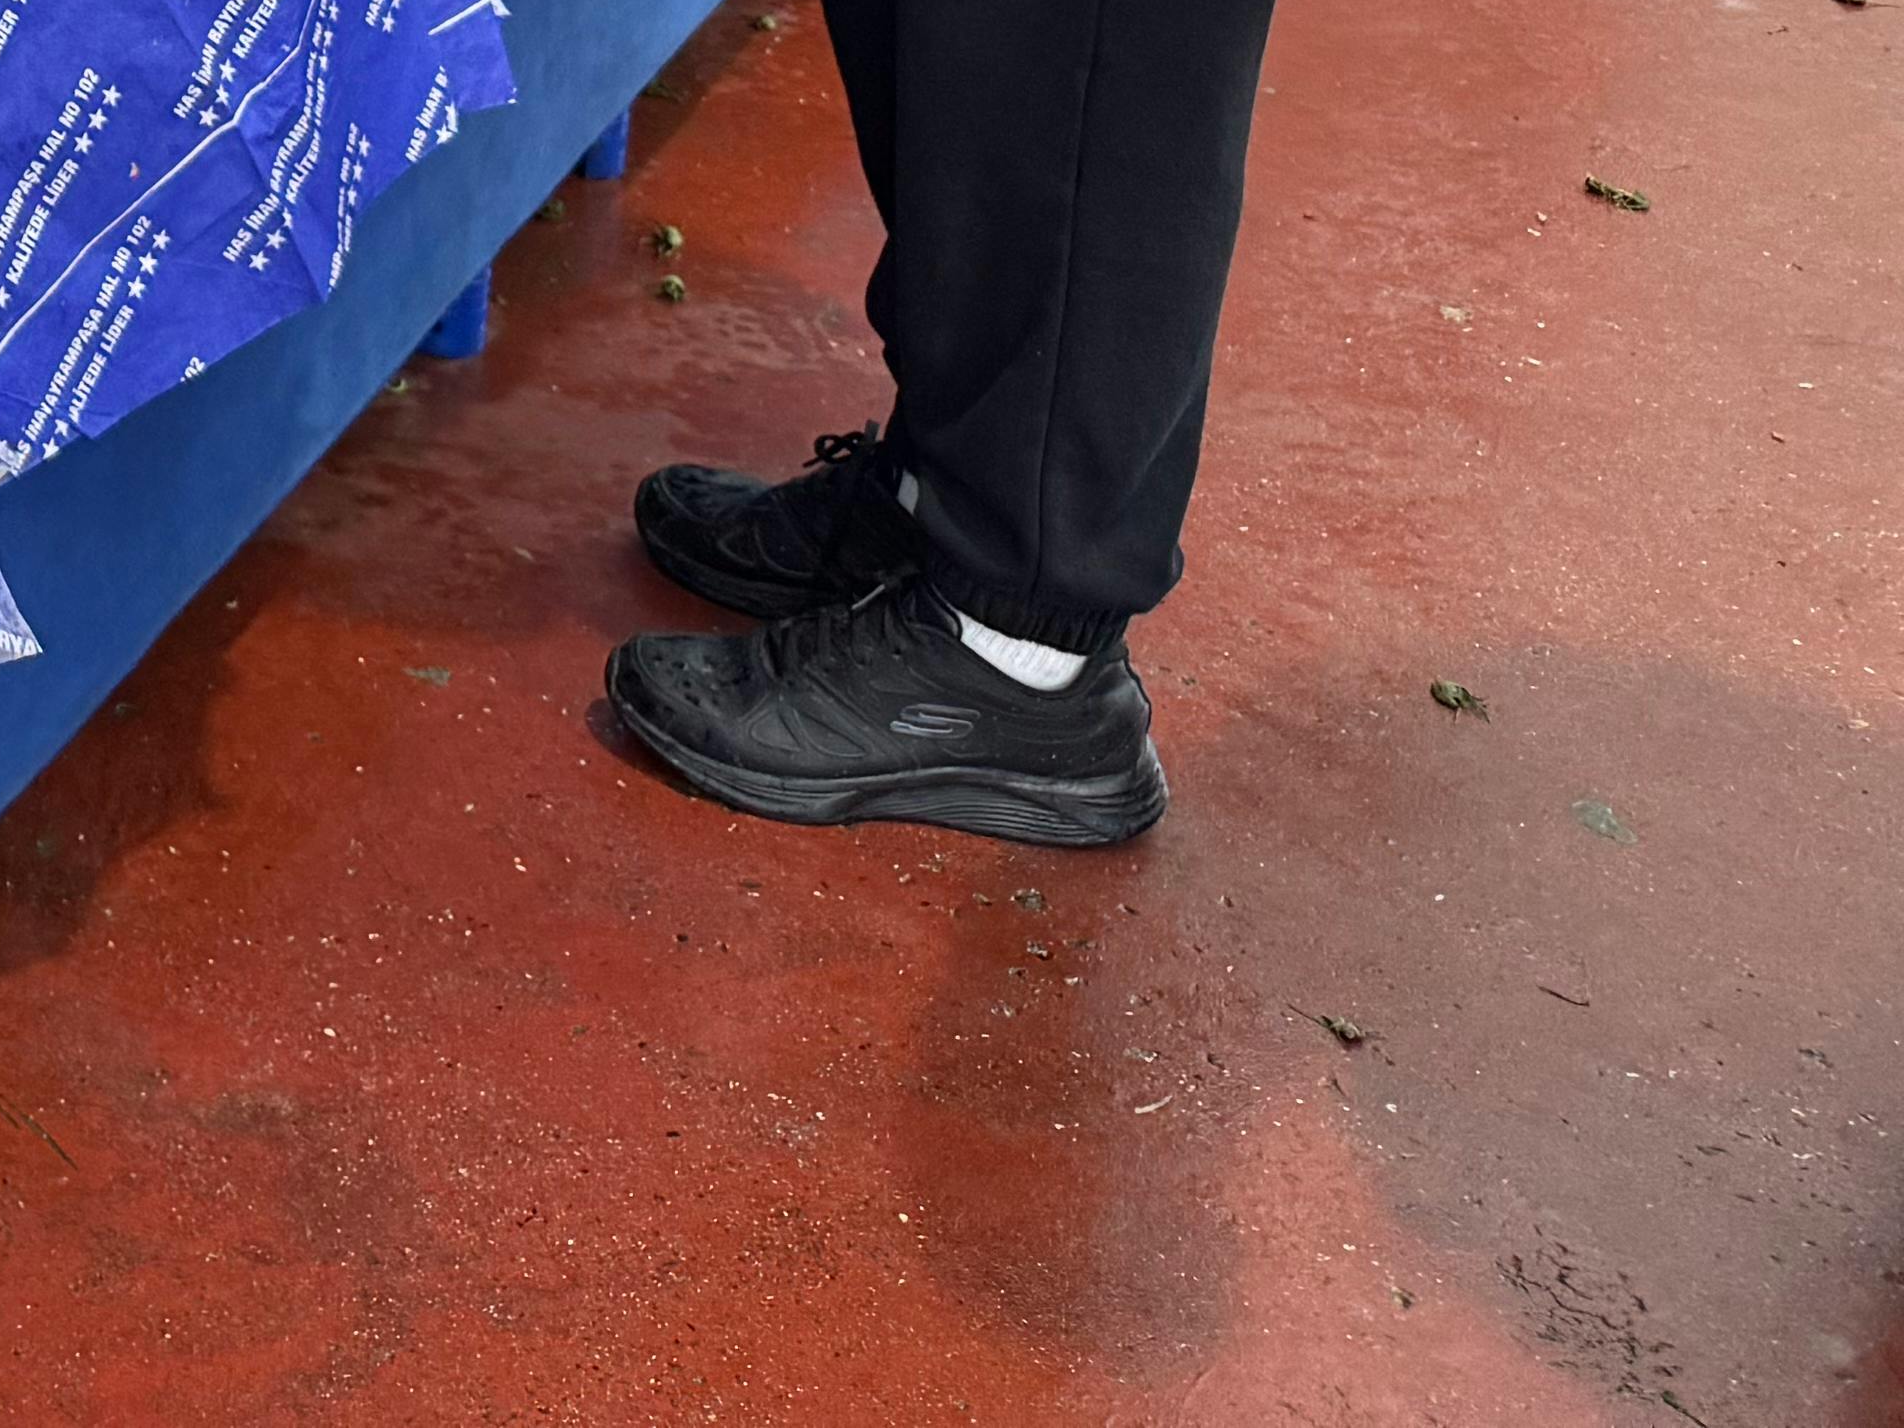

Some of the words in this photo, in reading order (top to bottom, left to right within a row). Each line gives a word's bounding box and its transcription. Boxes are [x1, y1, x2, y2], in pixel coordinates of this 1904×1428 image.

[39, 125, 67, 162] HAL
[58, 101, 82, 130] NO
[73, 66, 101, 103] 102
[172, 82, 203, 120] HAS
[4, 203, 50, 287] KALİTEDE
[42, 157, 82, 207] LİDER
